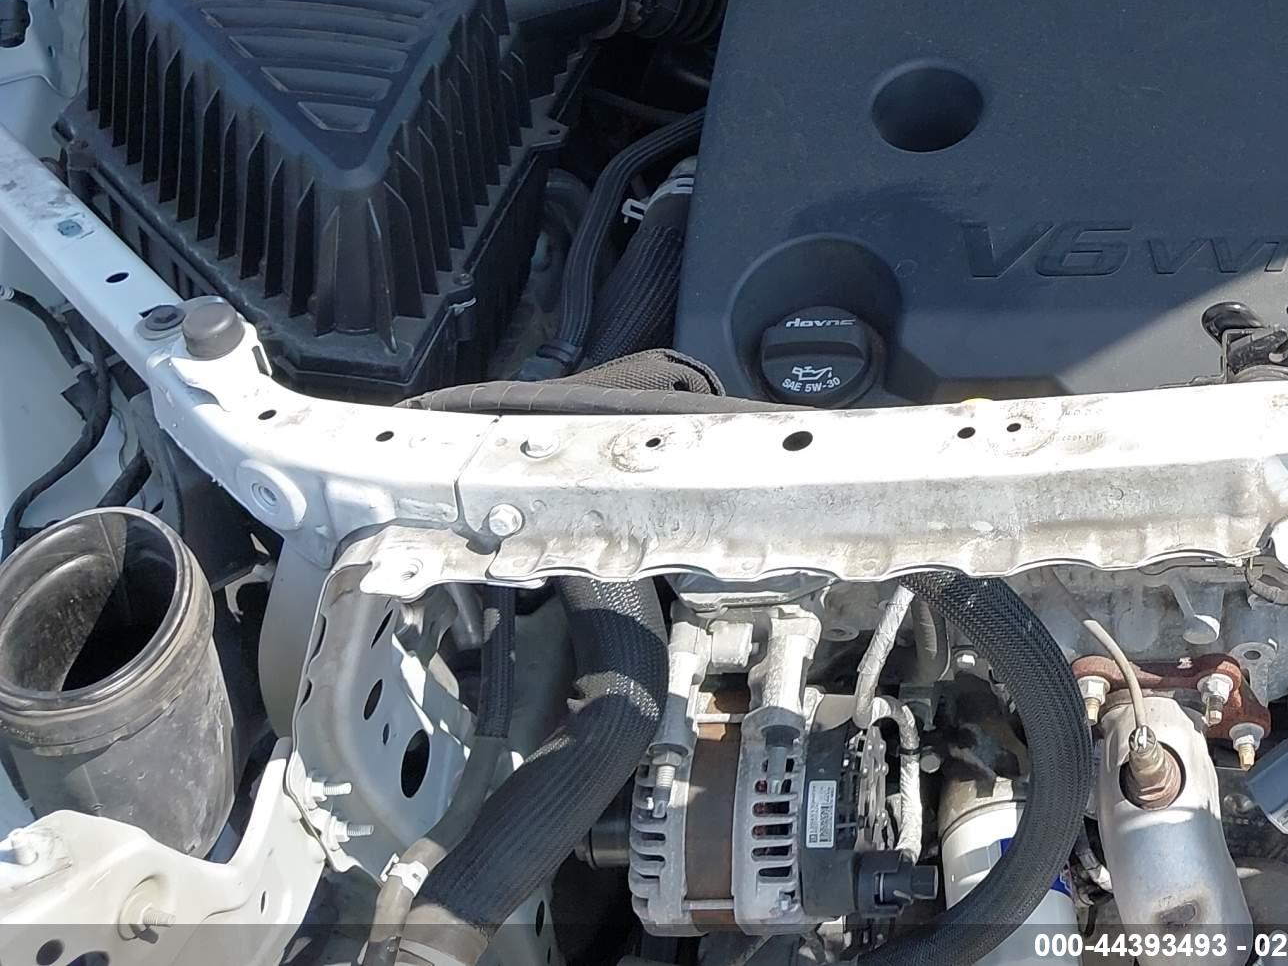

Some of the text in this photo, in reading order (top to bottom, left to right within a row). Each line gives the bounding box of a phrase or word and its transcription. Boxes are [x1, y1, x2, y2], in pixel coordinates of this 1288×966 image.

[960, 220, 1134, 279] V6
[782, 376, 841, 393] SAE 5W-30
